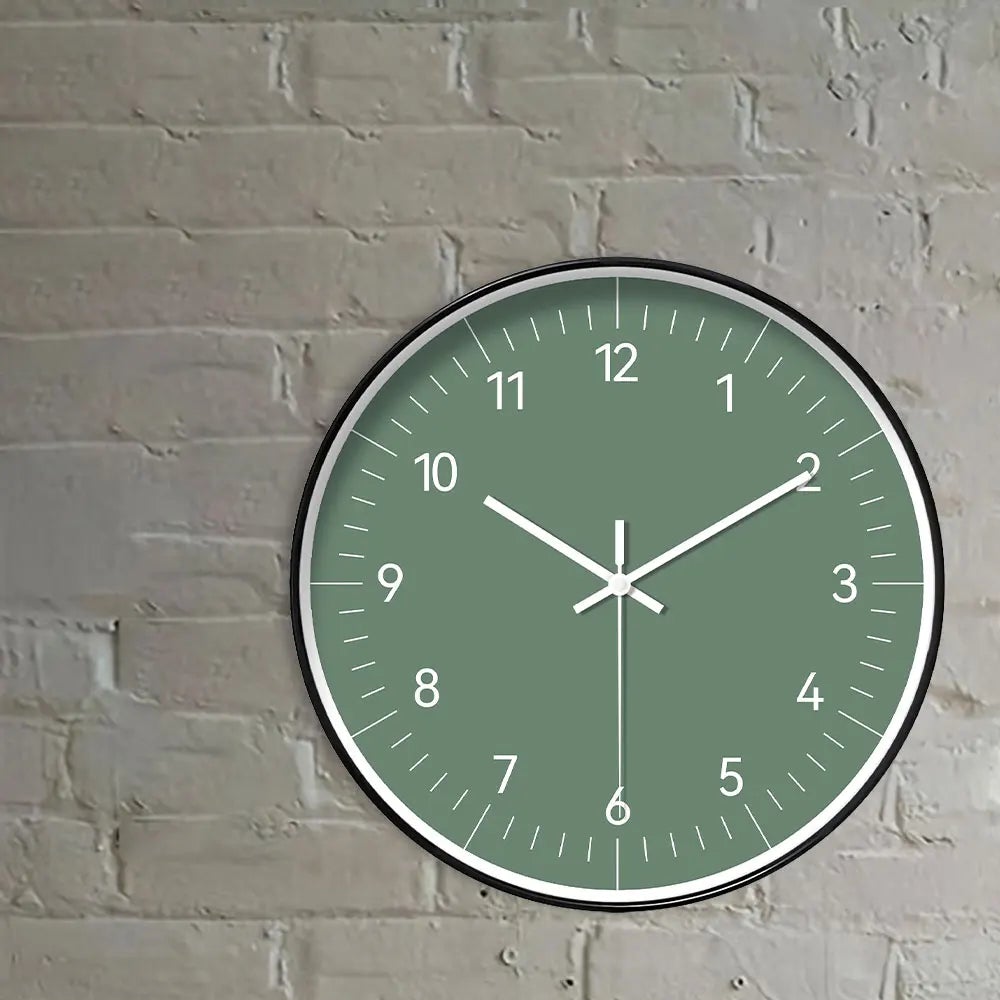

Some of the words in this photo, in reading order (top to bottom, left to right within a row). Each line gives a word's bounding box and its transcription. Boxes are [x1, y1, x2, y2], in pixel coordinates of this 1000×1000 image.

[595, 342, 639, 382] 12
[486, 371, 524, 410] 11
[716, 373, 733, 413] 1
[414, 451, 458, 492] 10
[796, 452, 821, 492] 2
[377, 562, 404, 603] 9
[833, 563, 858, 604] 3
[414, 667, 440, 708] 8
[796, 671, 825, 711] 4
[493, 754, 518, 794] 7
[719, 757, 744, 797] 5
[605, 785, 631, 826] 6
